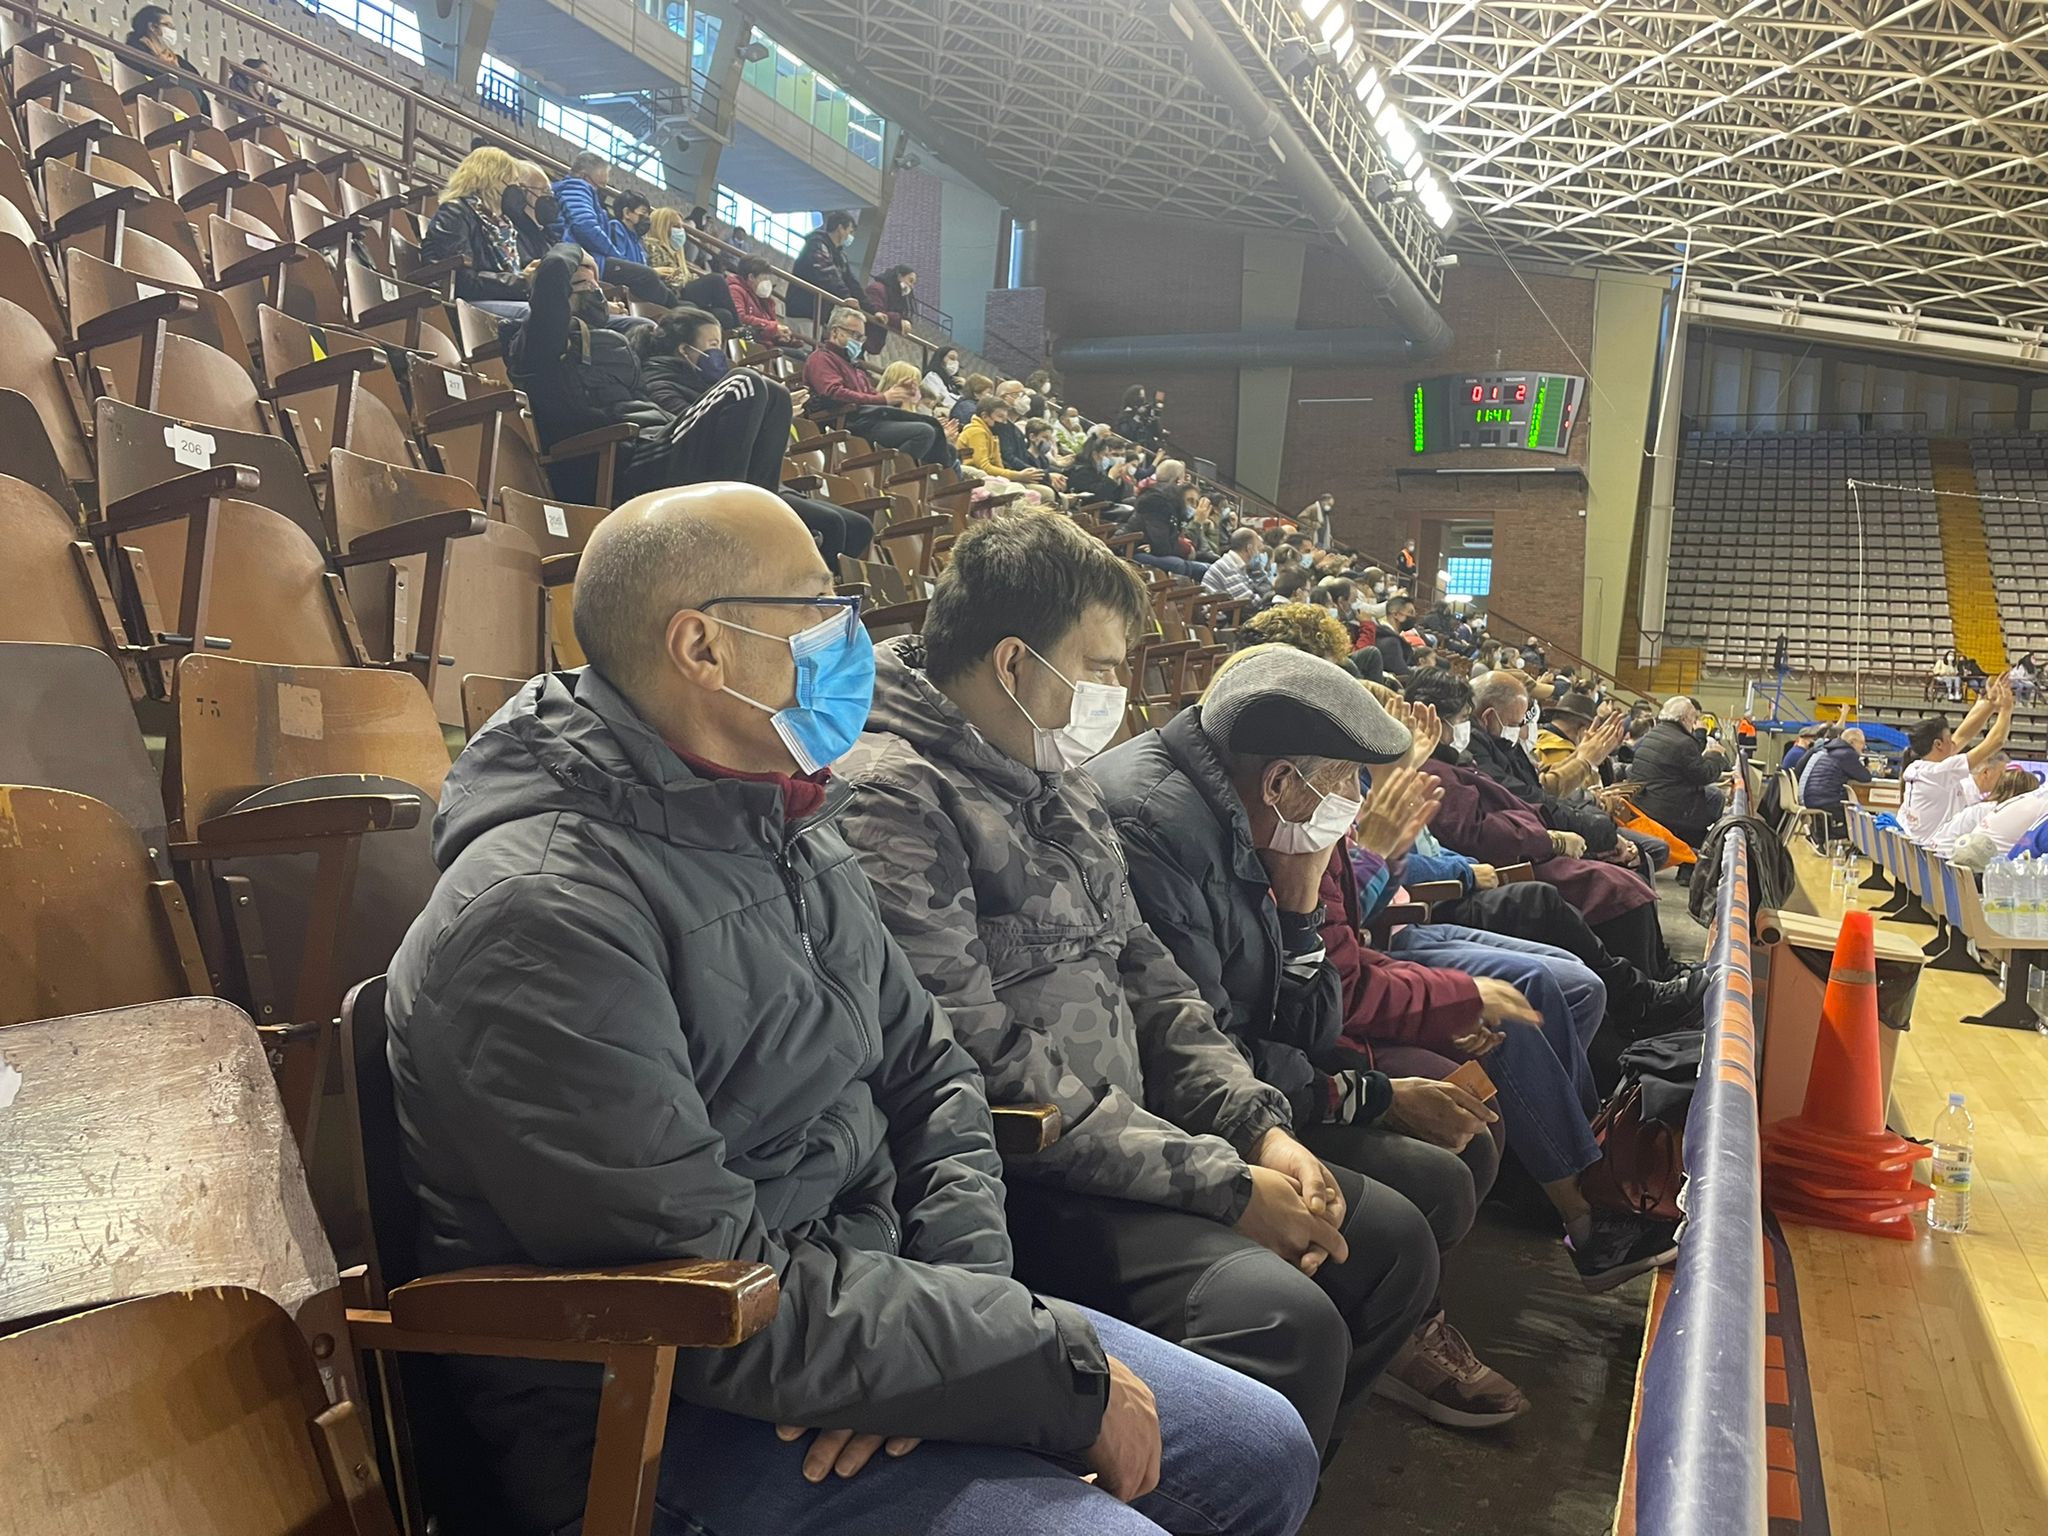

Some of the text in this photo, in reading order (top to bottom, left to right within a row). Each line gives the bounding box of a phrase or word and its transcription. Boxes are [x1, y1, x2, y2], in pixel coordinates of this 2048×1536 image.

[1515, 384, 1526, 401] 2
[1476, 408, 1511, 423] 11:41
[180, 439, 202, 455] 206
